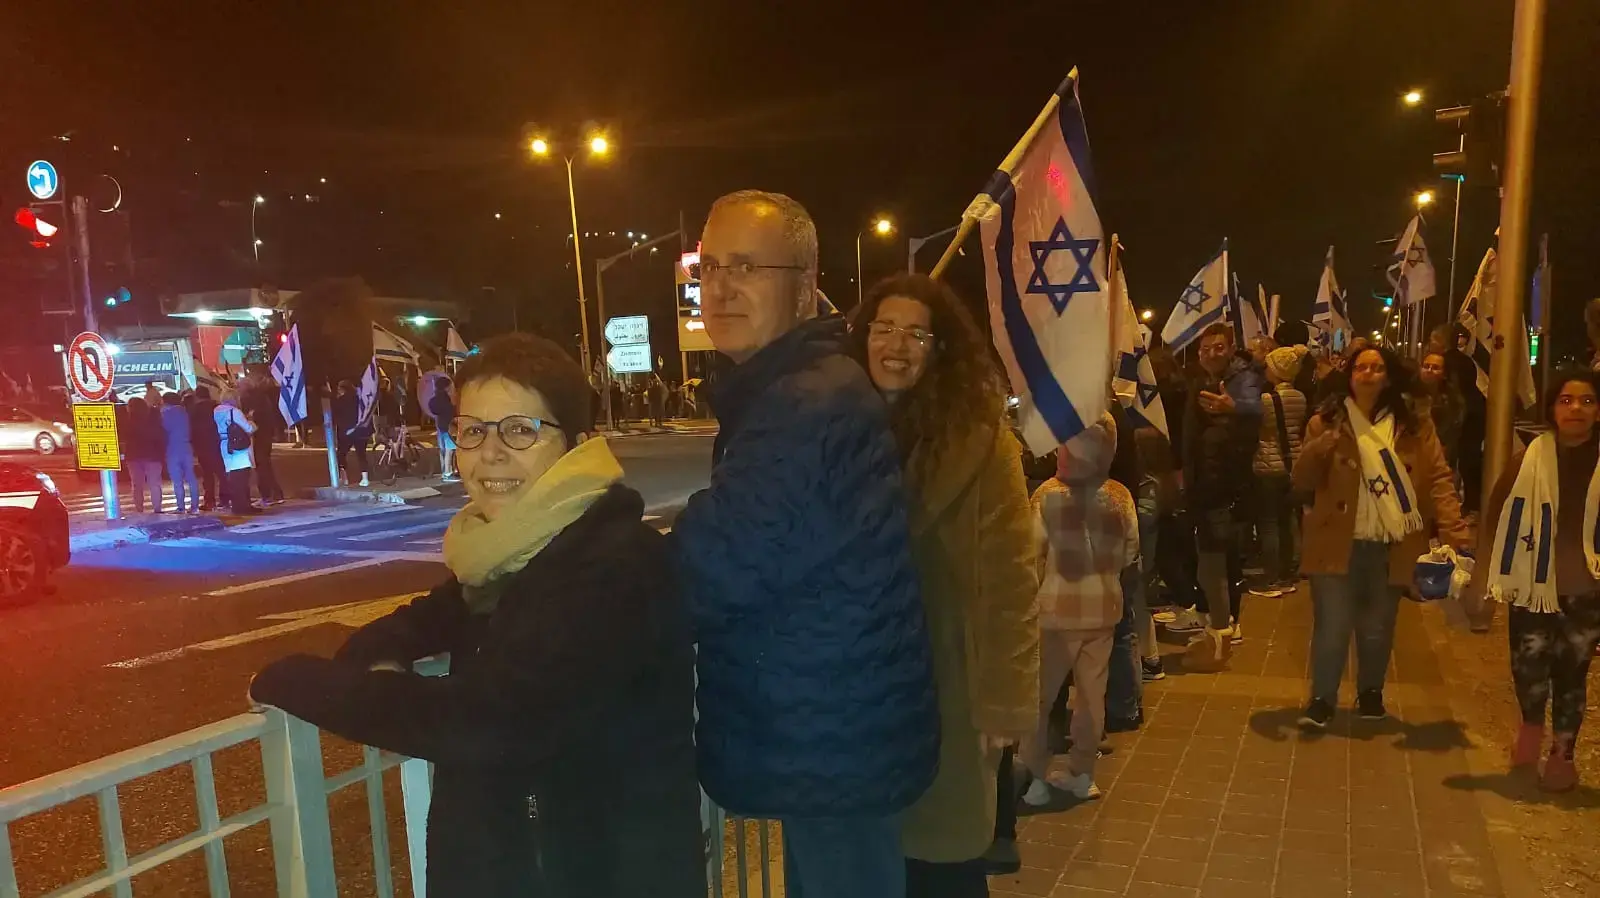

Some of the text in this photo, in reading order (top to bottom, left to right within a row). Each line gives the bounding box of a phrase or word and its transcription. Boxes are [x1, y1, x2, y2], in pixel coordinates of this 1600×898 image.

[115, 363, 172, 372] ICHELIN
[87, 443, 108, 456] 4 טון
